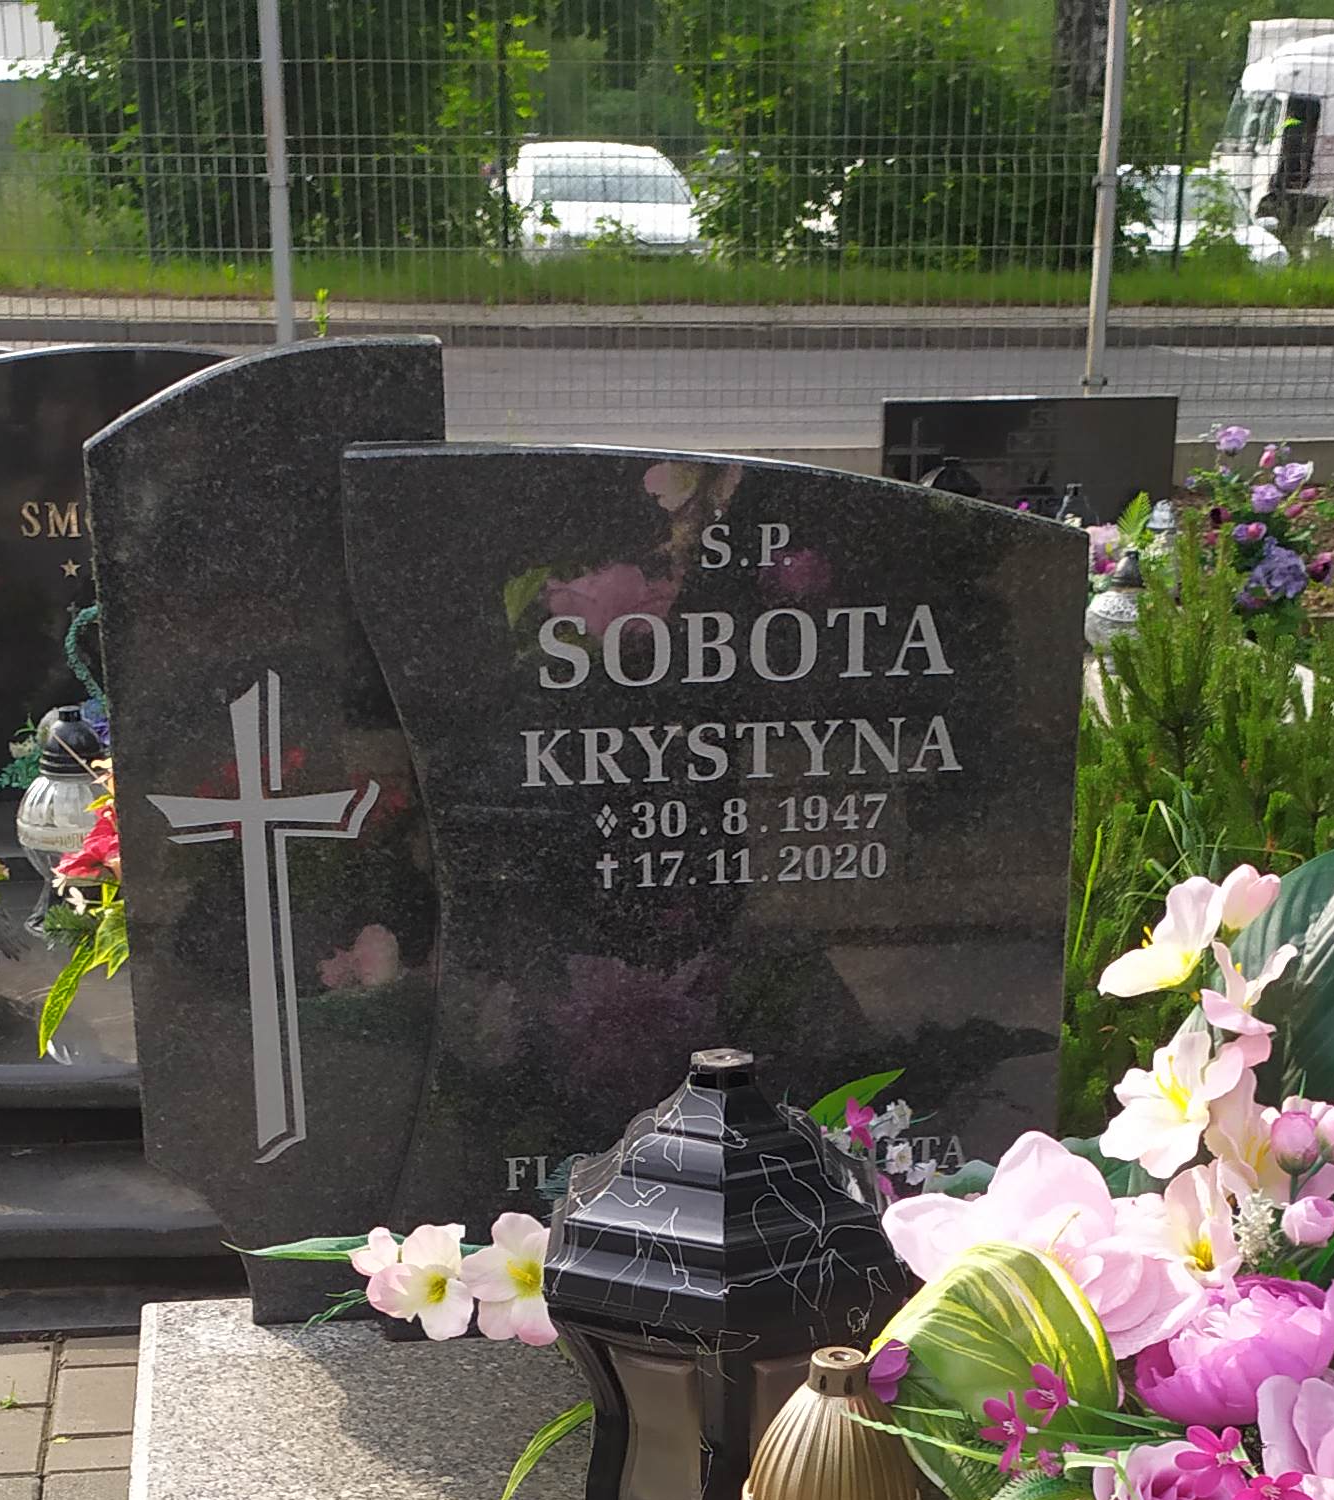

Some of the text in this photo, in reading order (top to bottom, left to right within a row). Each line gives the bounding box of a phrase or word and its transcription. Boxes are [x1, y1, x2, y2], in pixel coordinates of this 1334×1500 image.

[20, 500, 91, 540] SM
[538, 604, 955, 690] SOBOTA
[520, 715, 963, 787] KRYSTYNA
[635, 842, 887, 888] 17.11.2020
